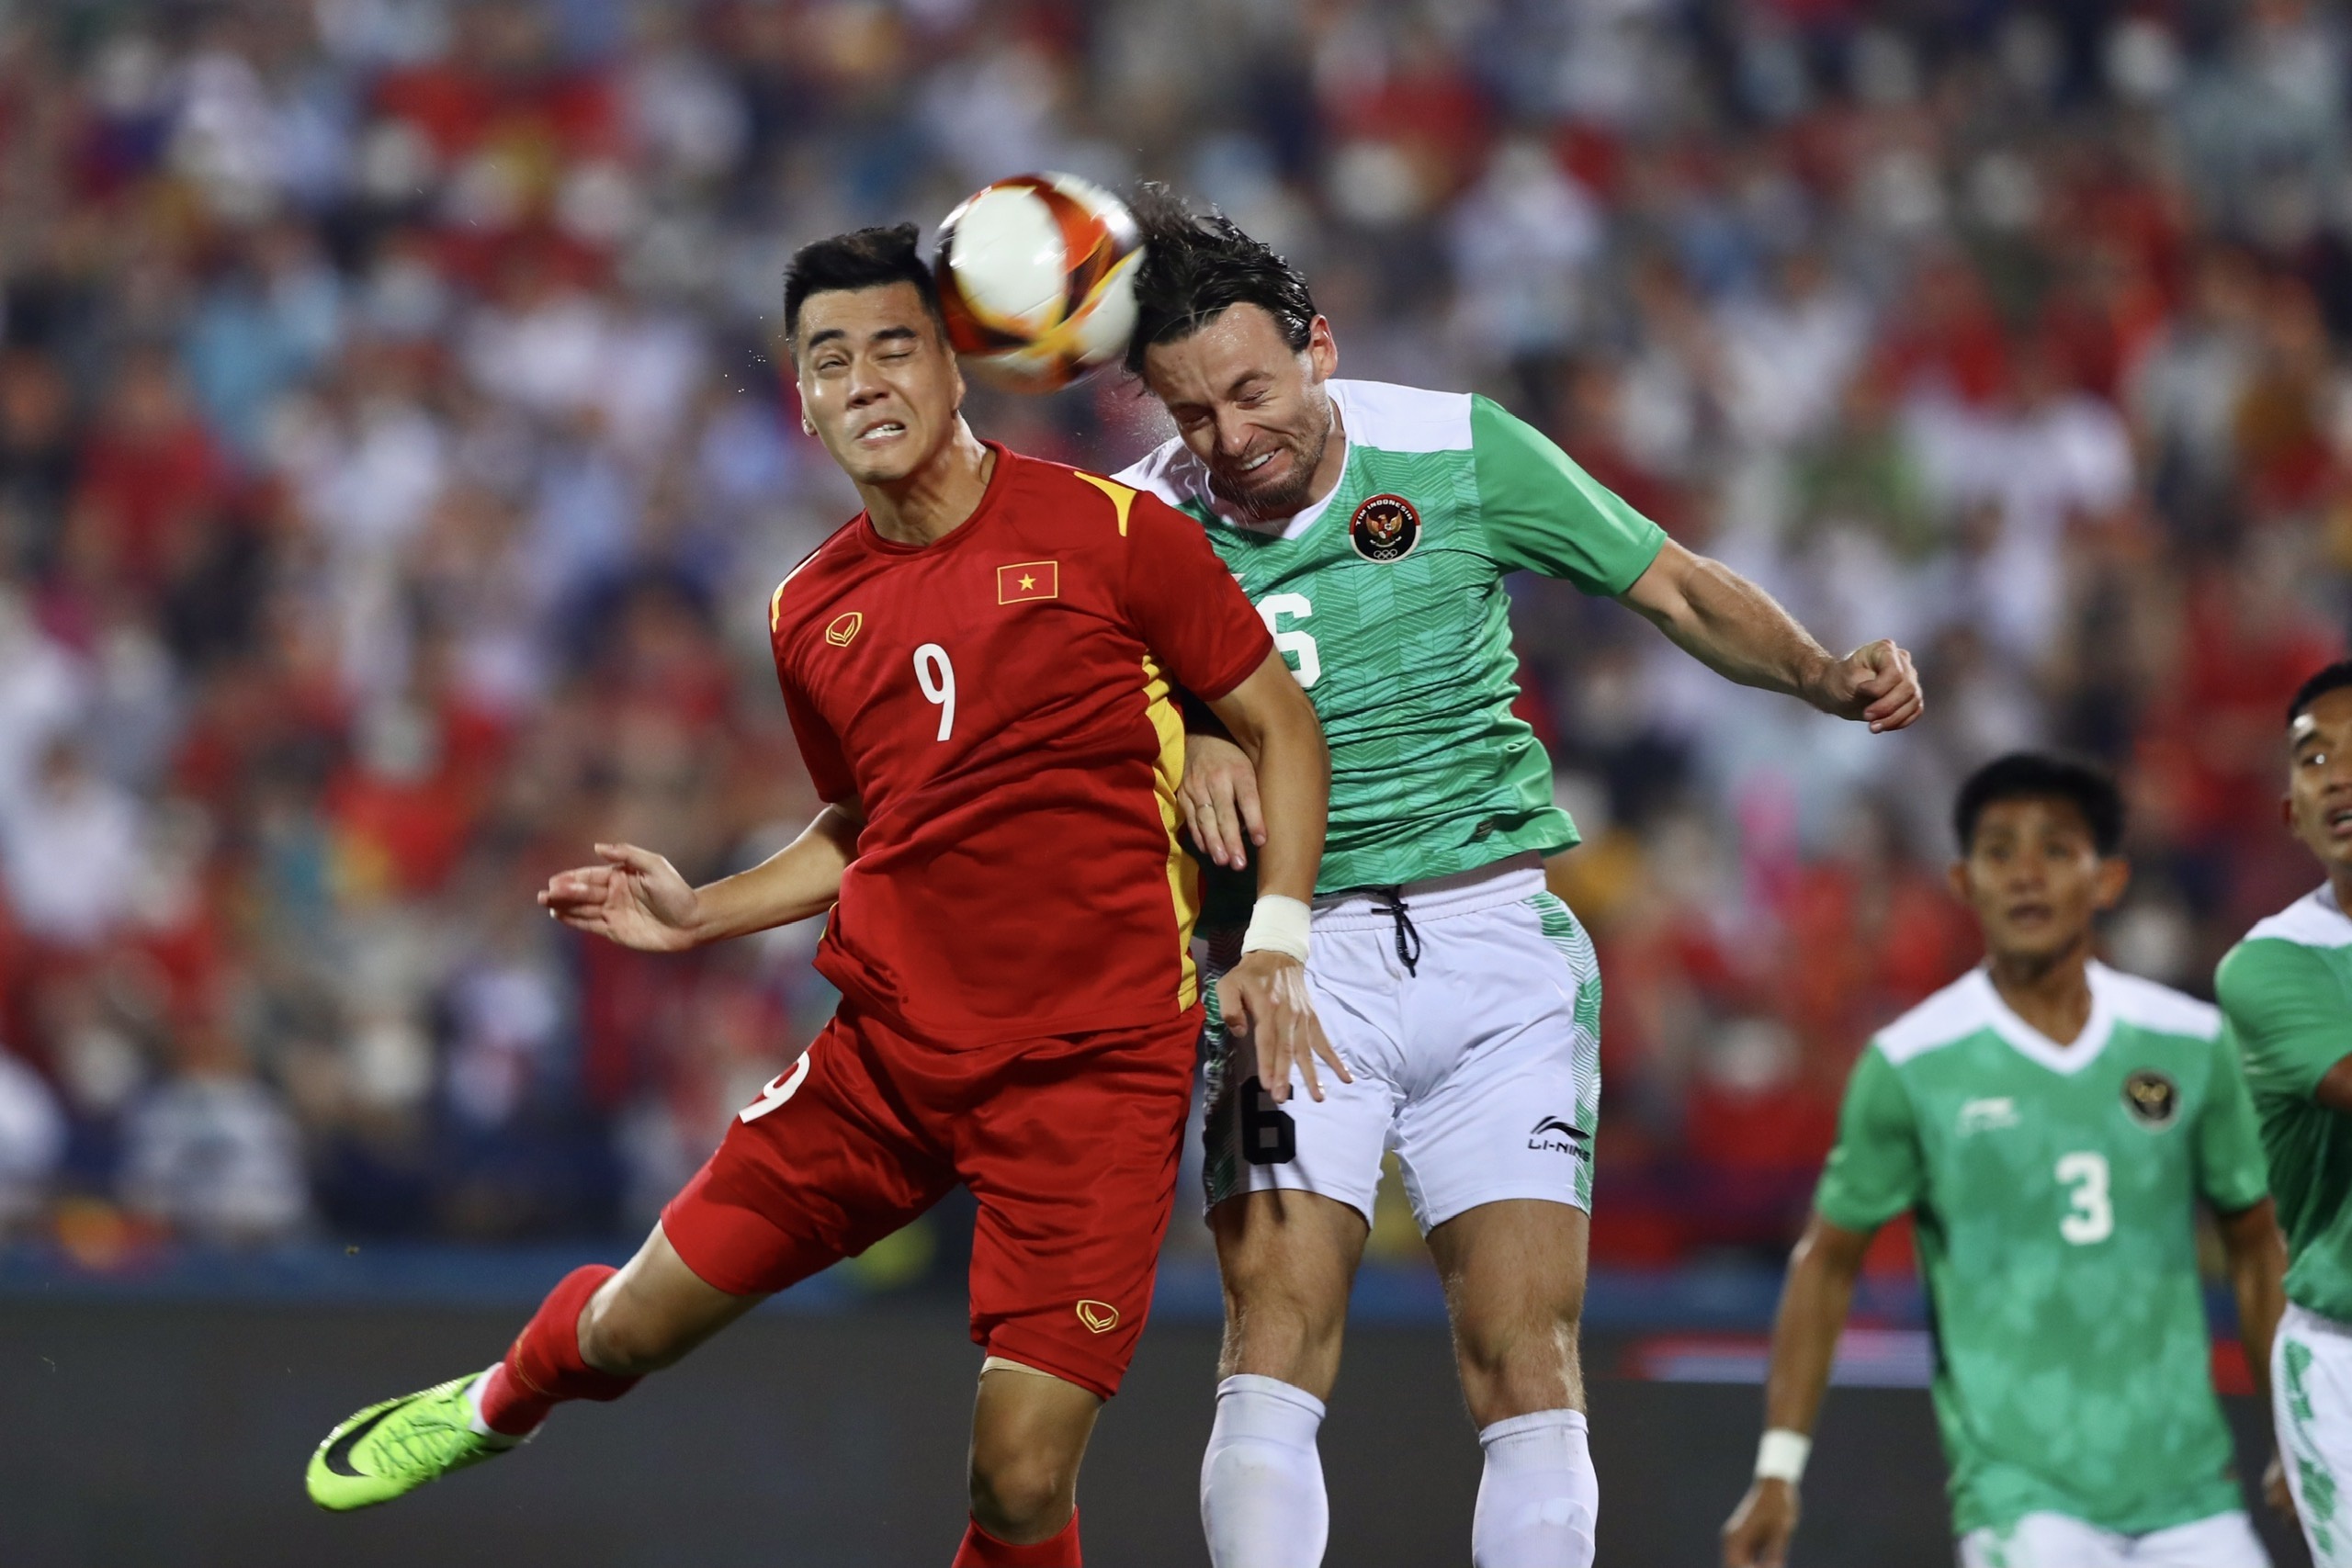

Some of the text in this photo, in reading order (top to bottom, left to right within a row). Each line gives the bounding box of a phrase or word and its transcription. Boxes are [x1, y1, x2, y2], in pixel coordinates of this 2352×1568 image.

[1355, 499, 1413, 526] TIM INDONESIA
[912, 642, 956, 742] 9
[738, 1050, 811, 1124] 9
[1240, 1075, 1296, 1166] 6
[2055, 1150, 2115, 1246] 3
